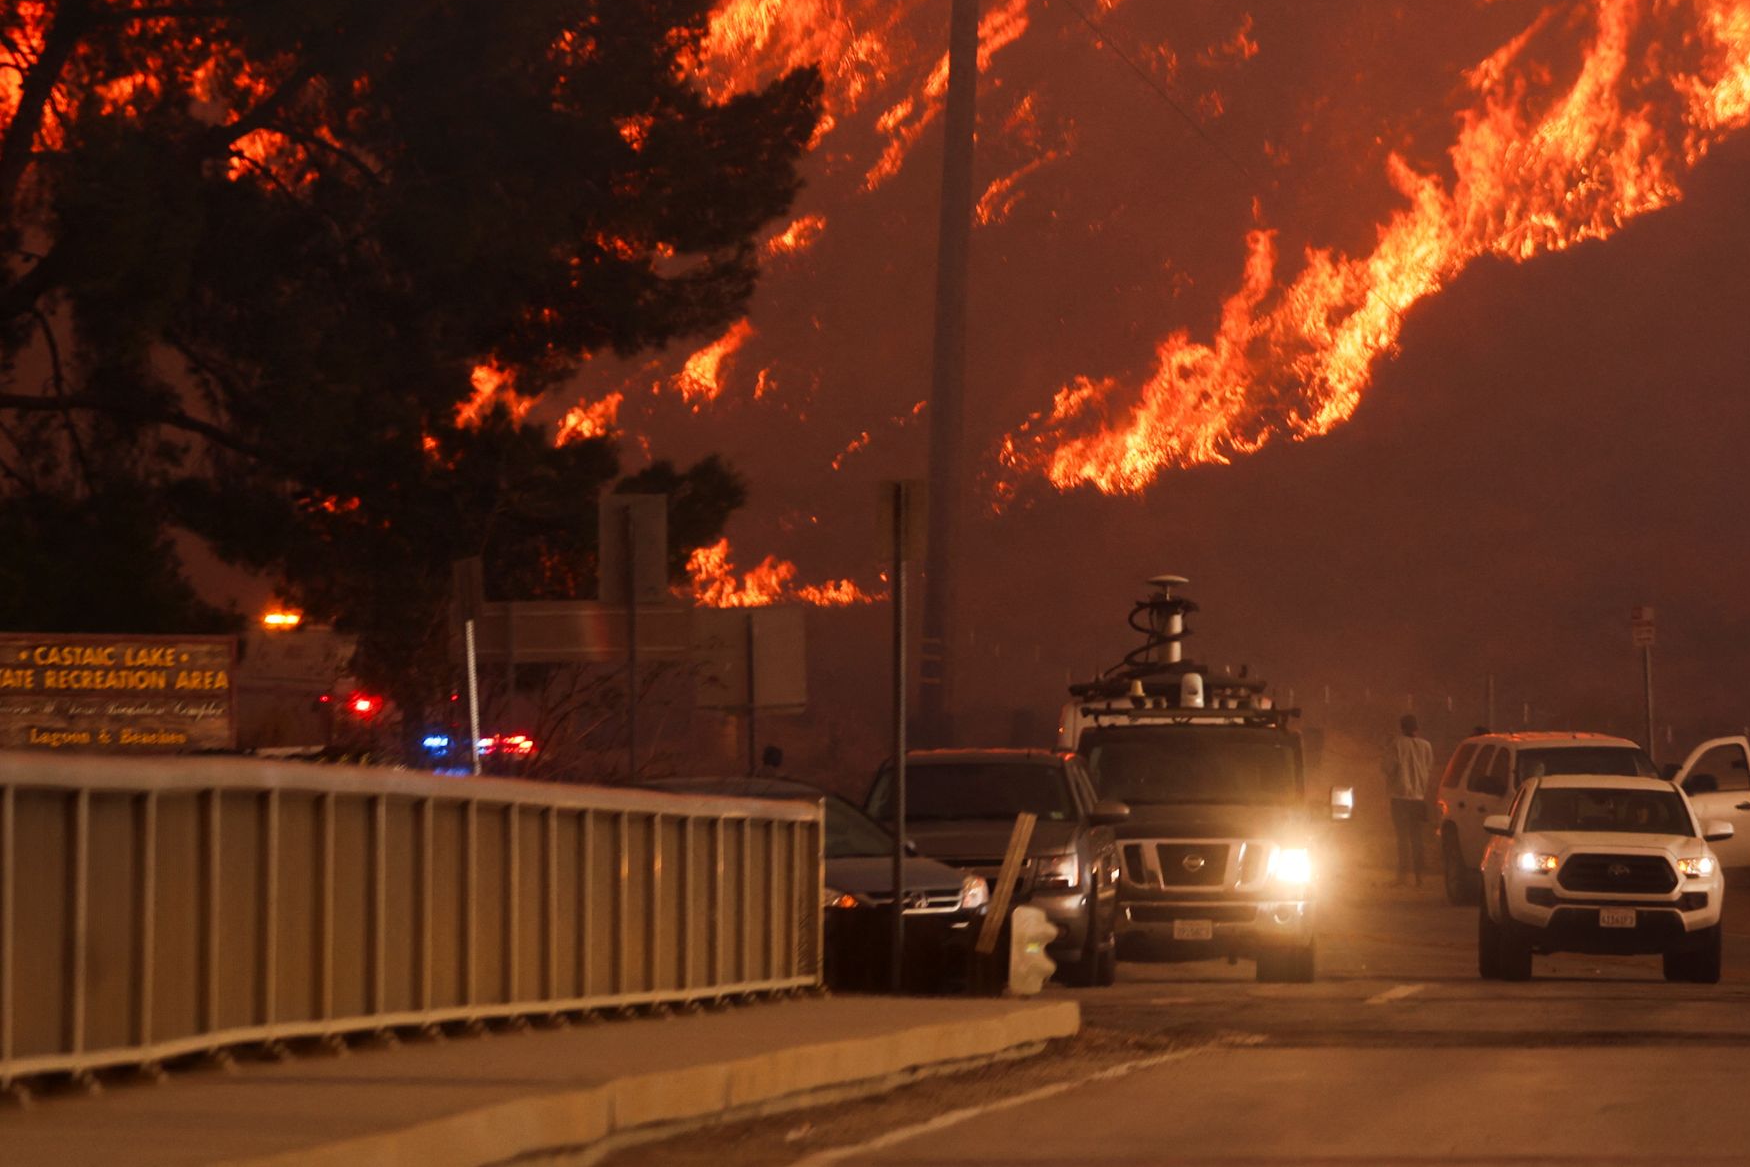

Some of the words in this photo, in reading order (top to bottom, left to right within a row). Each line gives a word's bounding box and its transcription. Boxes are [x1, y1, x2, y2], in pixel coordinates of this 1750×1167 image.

[33, 646, 117, 666] CASTAIC
[123, 646, 177, 667] LAKE
[44, 669, 168, 690] RECREATION
[174, 670, 230, 690] AREA
[30, 727, 92, 747] Lagoon
[97, 728, 113, 746] &
